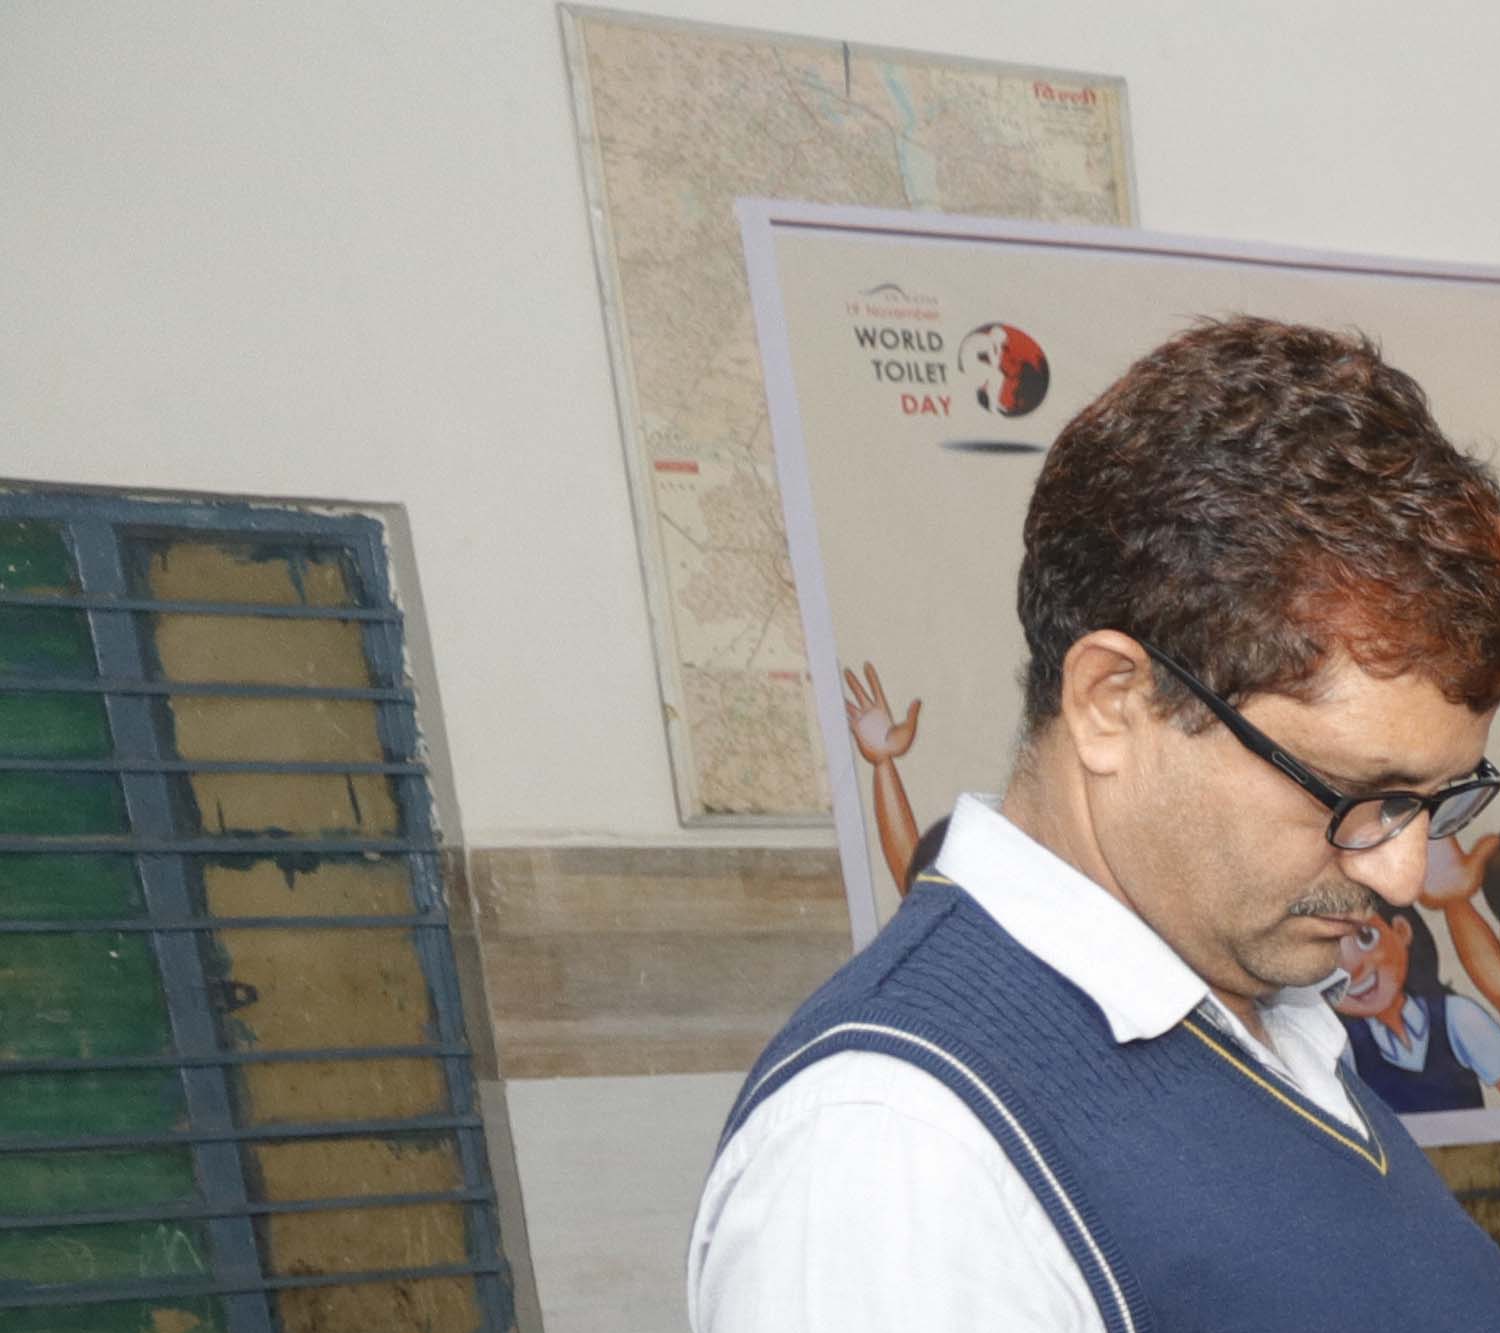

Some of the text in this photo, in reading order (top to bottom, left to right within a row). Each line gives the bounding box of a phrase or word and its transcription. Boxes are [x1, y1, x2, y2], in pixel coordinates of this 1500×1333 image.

[853, 325, 944, 352] WORLD
[872, 359, 949, 384] TOILET
[900, 393, 952, 417] DAY
